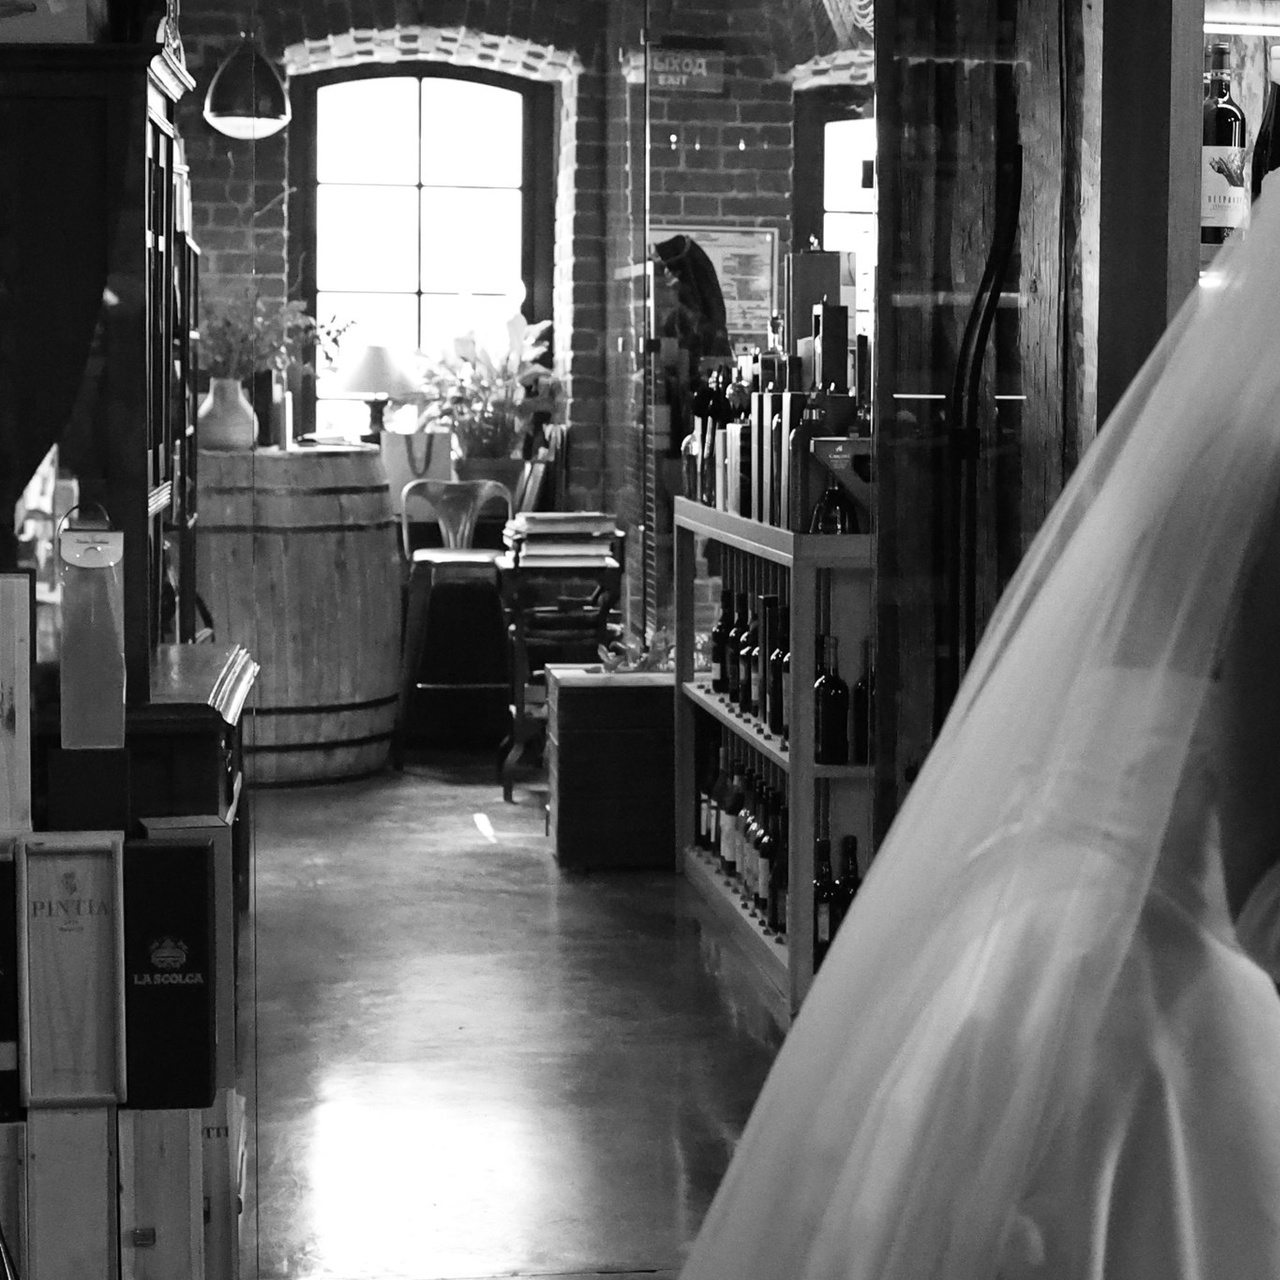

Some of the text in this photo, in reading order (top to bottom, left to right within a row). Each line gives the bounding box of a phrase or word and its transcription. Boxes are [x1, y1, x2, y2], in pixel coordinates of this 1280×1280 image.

[649, 57, 708, 77] ЫХОД
[33, 900, 110, 918] PINTIA
[133, 973, 152, 986] LA
